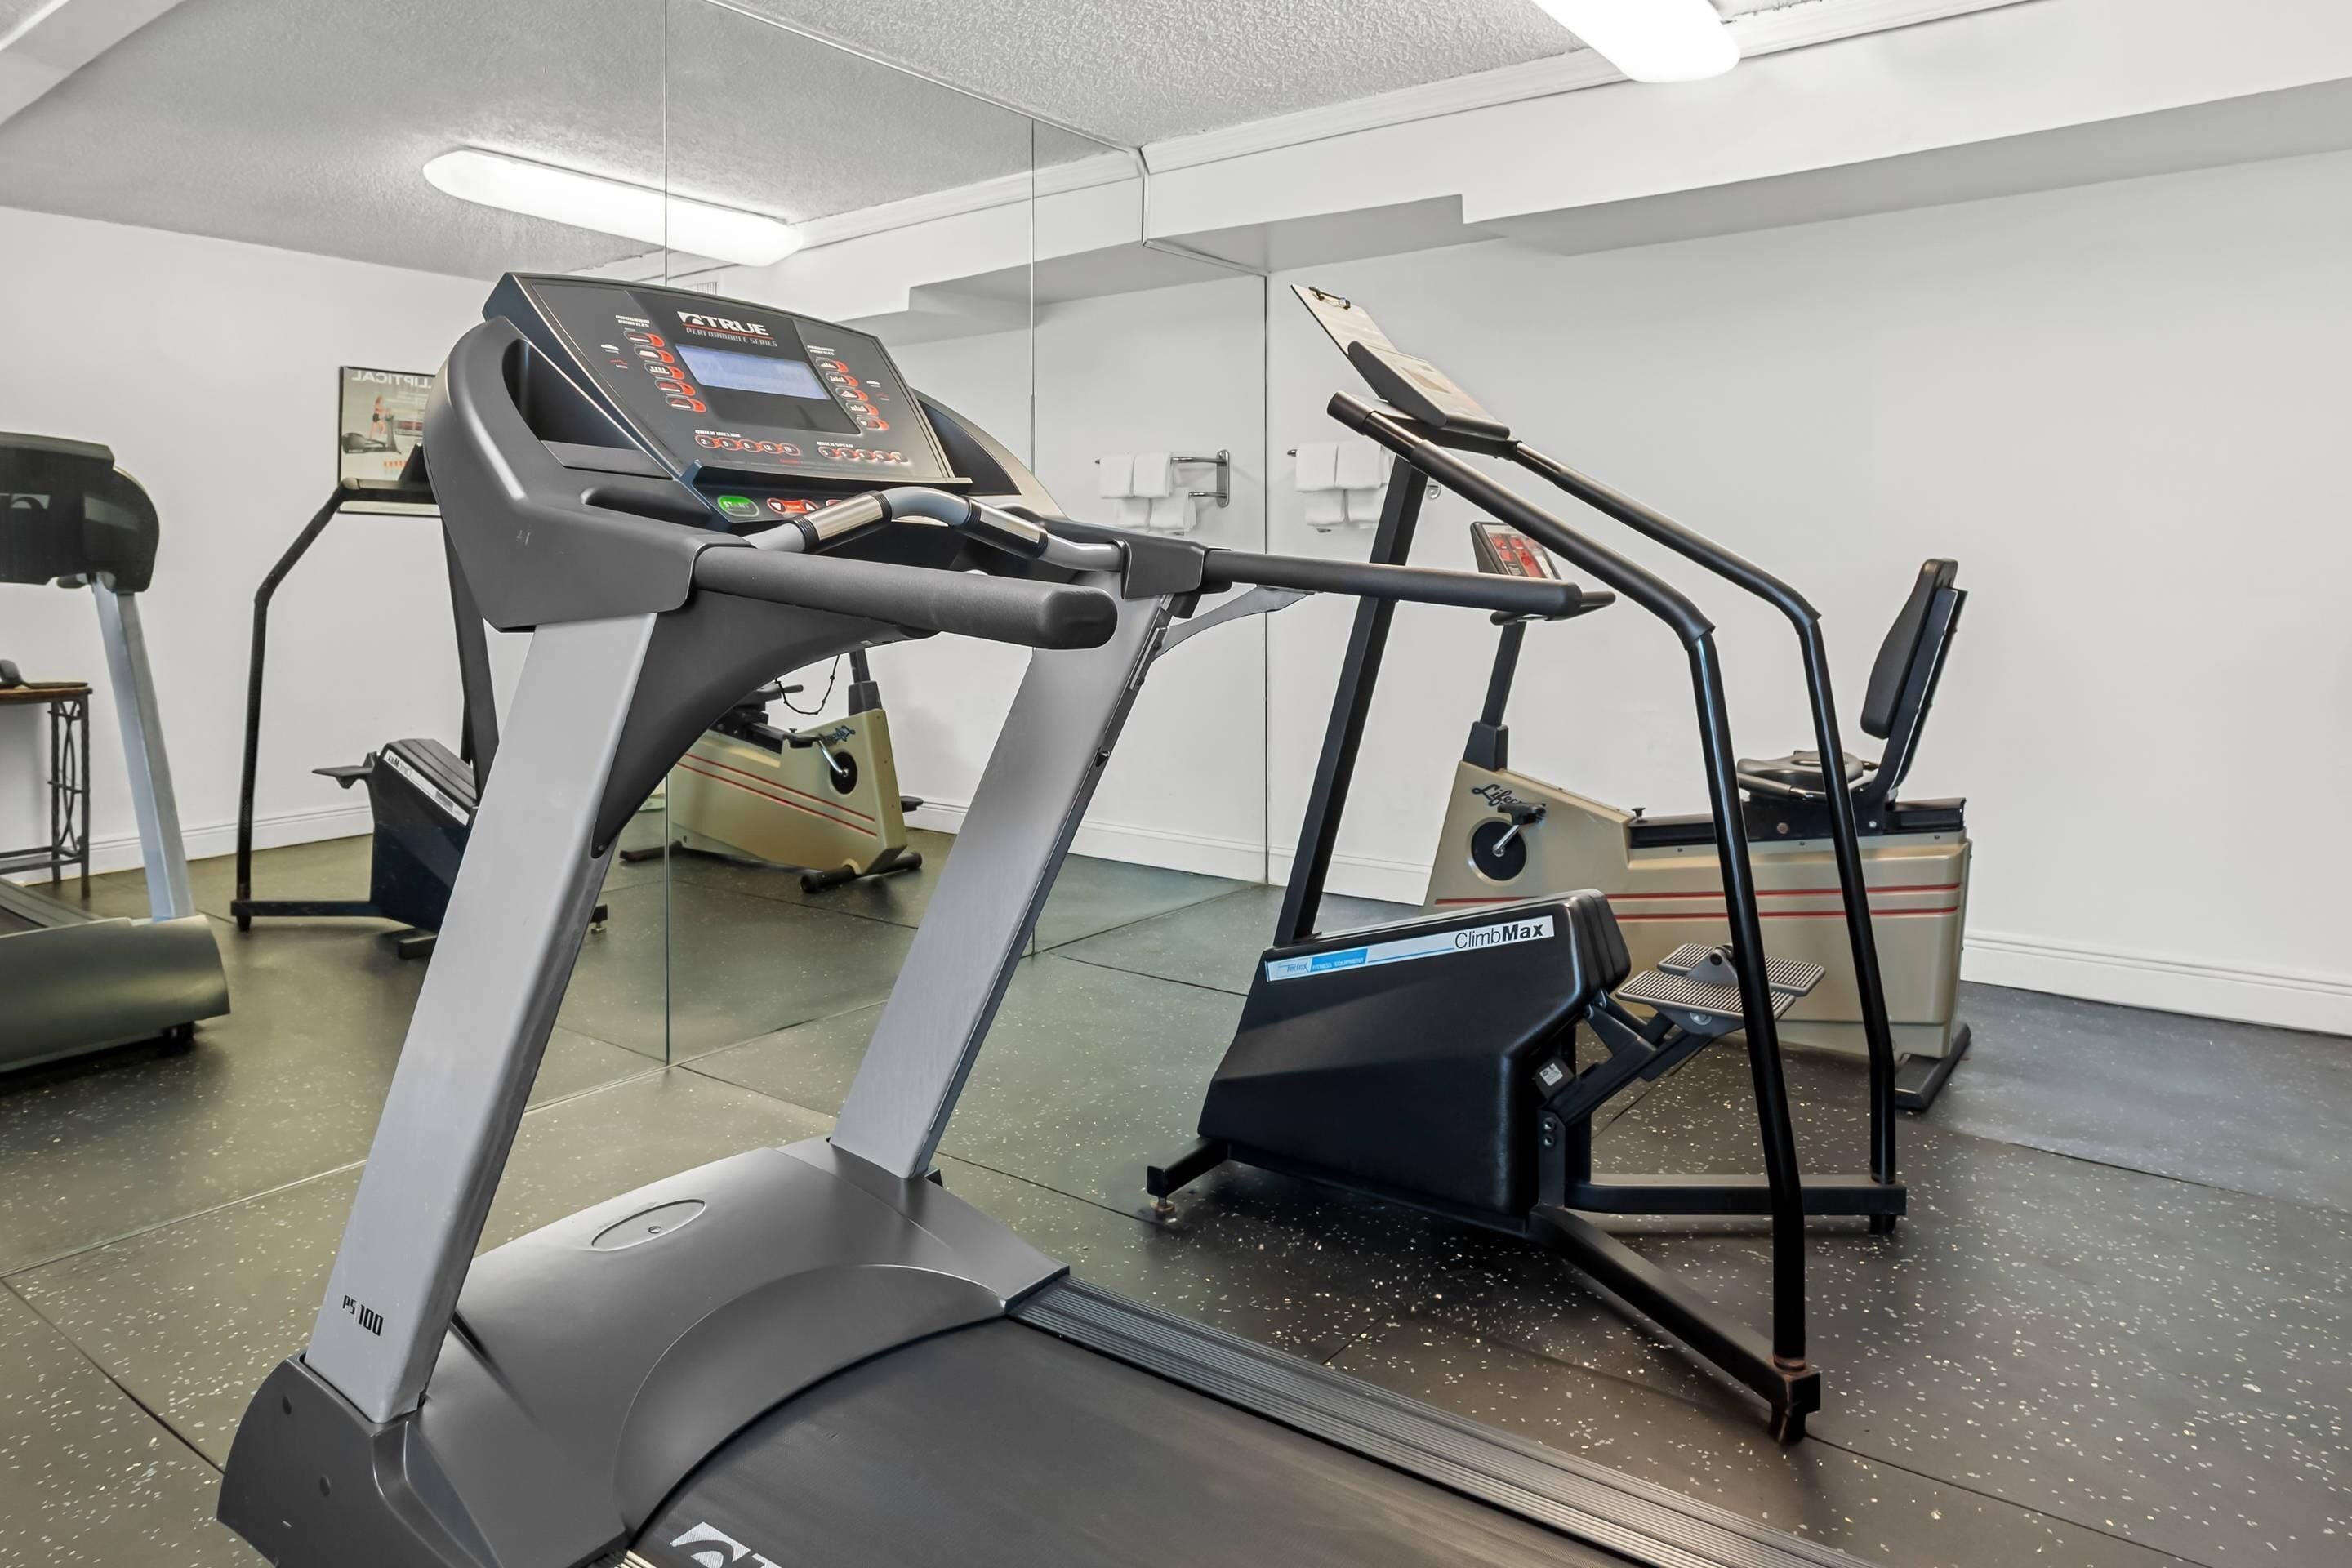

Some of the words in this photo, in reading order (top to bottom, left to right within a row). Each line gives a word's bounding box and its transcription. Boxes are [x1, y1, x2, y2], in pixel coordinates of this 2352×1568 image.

[699, 314, 770, 336] TRUE
[1454, 923, 1544, 950] ClimbMax
[342, 1294, 357, 1315] PS
[359, 1304, 384, 1336] 100
